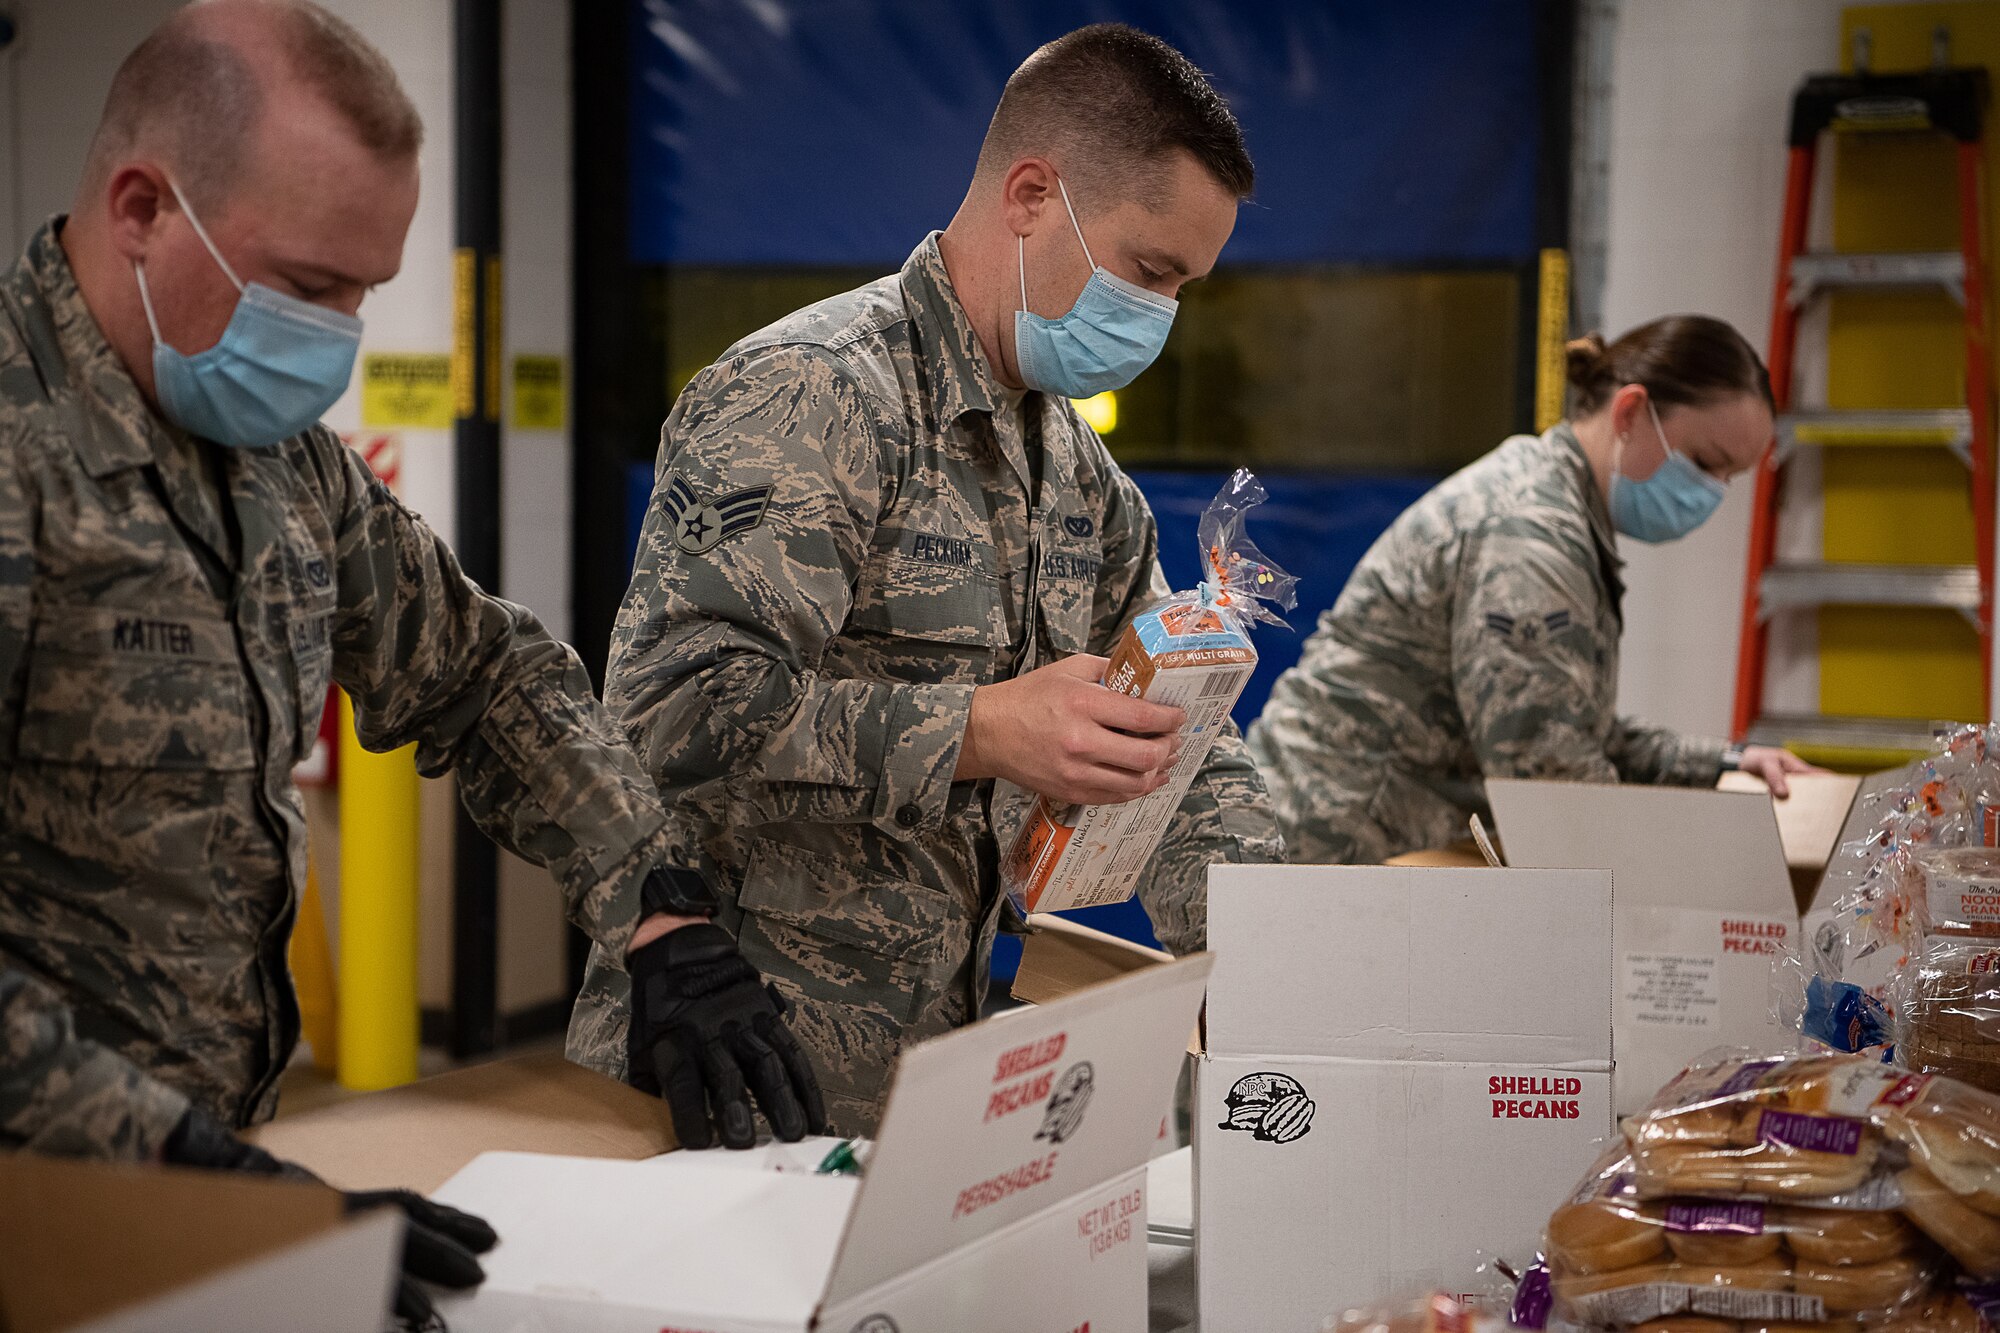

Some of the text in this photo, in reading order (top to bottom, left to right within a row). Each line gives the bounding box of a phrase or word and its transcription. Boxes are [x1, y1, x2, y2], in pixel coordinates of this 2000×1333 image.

[913, 534, 973, 567] PECKHAM
[1044, 553, 1069, 578] U.S.
[113, 618, 194, 654] KATTER
[1186, 649, 1216, 661] MULTI
[1217, 649, 1246, 659] GRAIN
[1117, 667, 1136, 694] RAIN
[1071, 821, 1092, 849] Nooks
[1721, 920, 1787, 938] SHELLED
[992, 1030, 1068, 1084] SHELLED
[983, 1069, 1056, 1125] PECANS
[1239, 1081, 1267, 1096] NPC
[1489, 1076, 1581, 1095] SHELLED
[1492, 1100, 1580, 1119] PECANS
[952, 1151, 1058, 1221] PERISHABLE
[1077, 1207, 1099, 1239] NET
